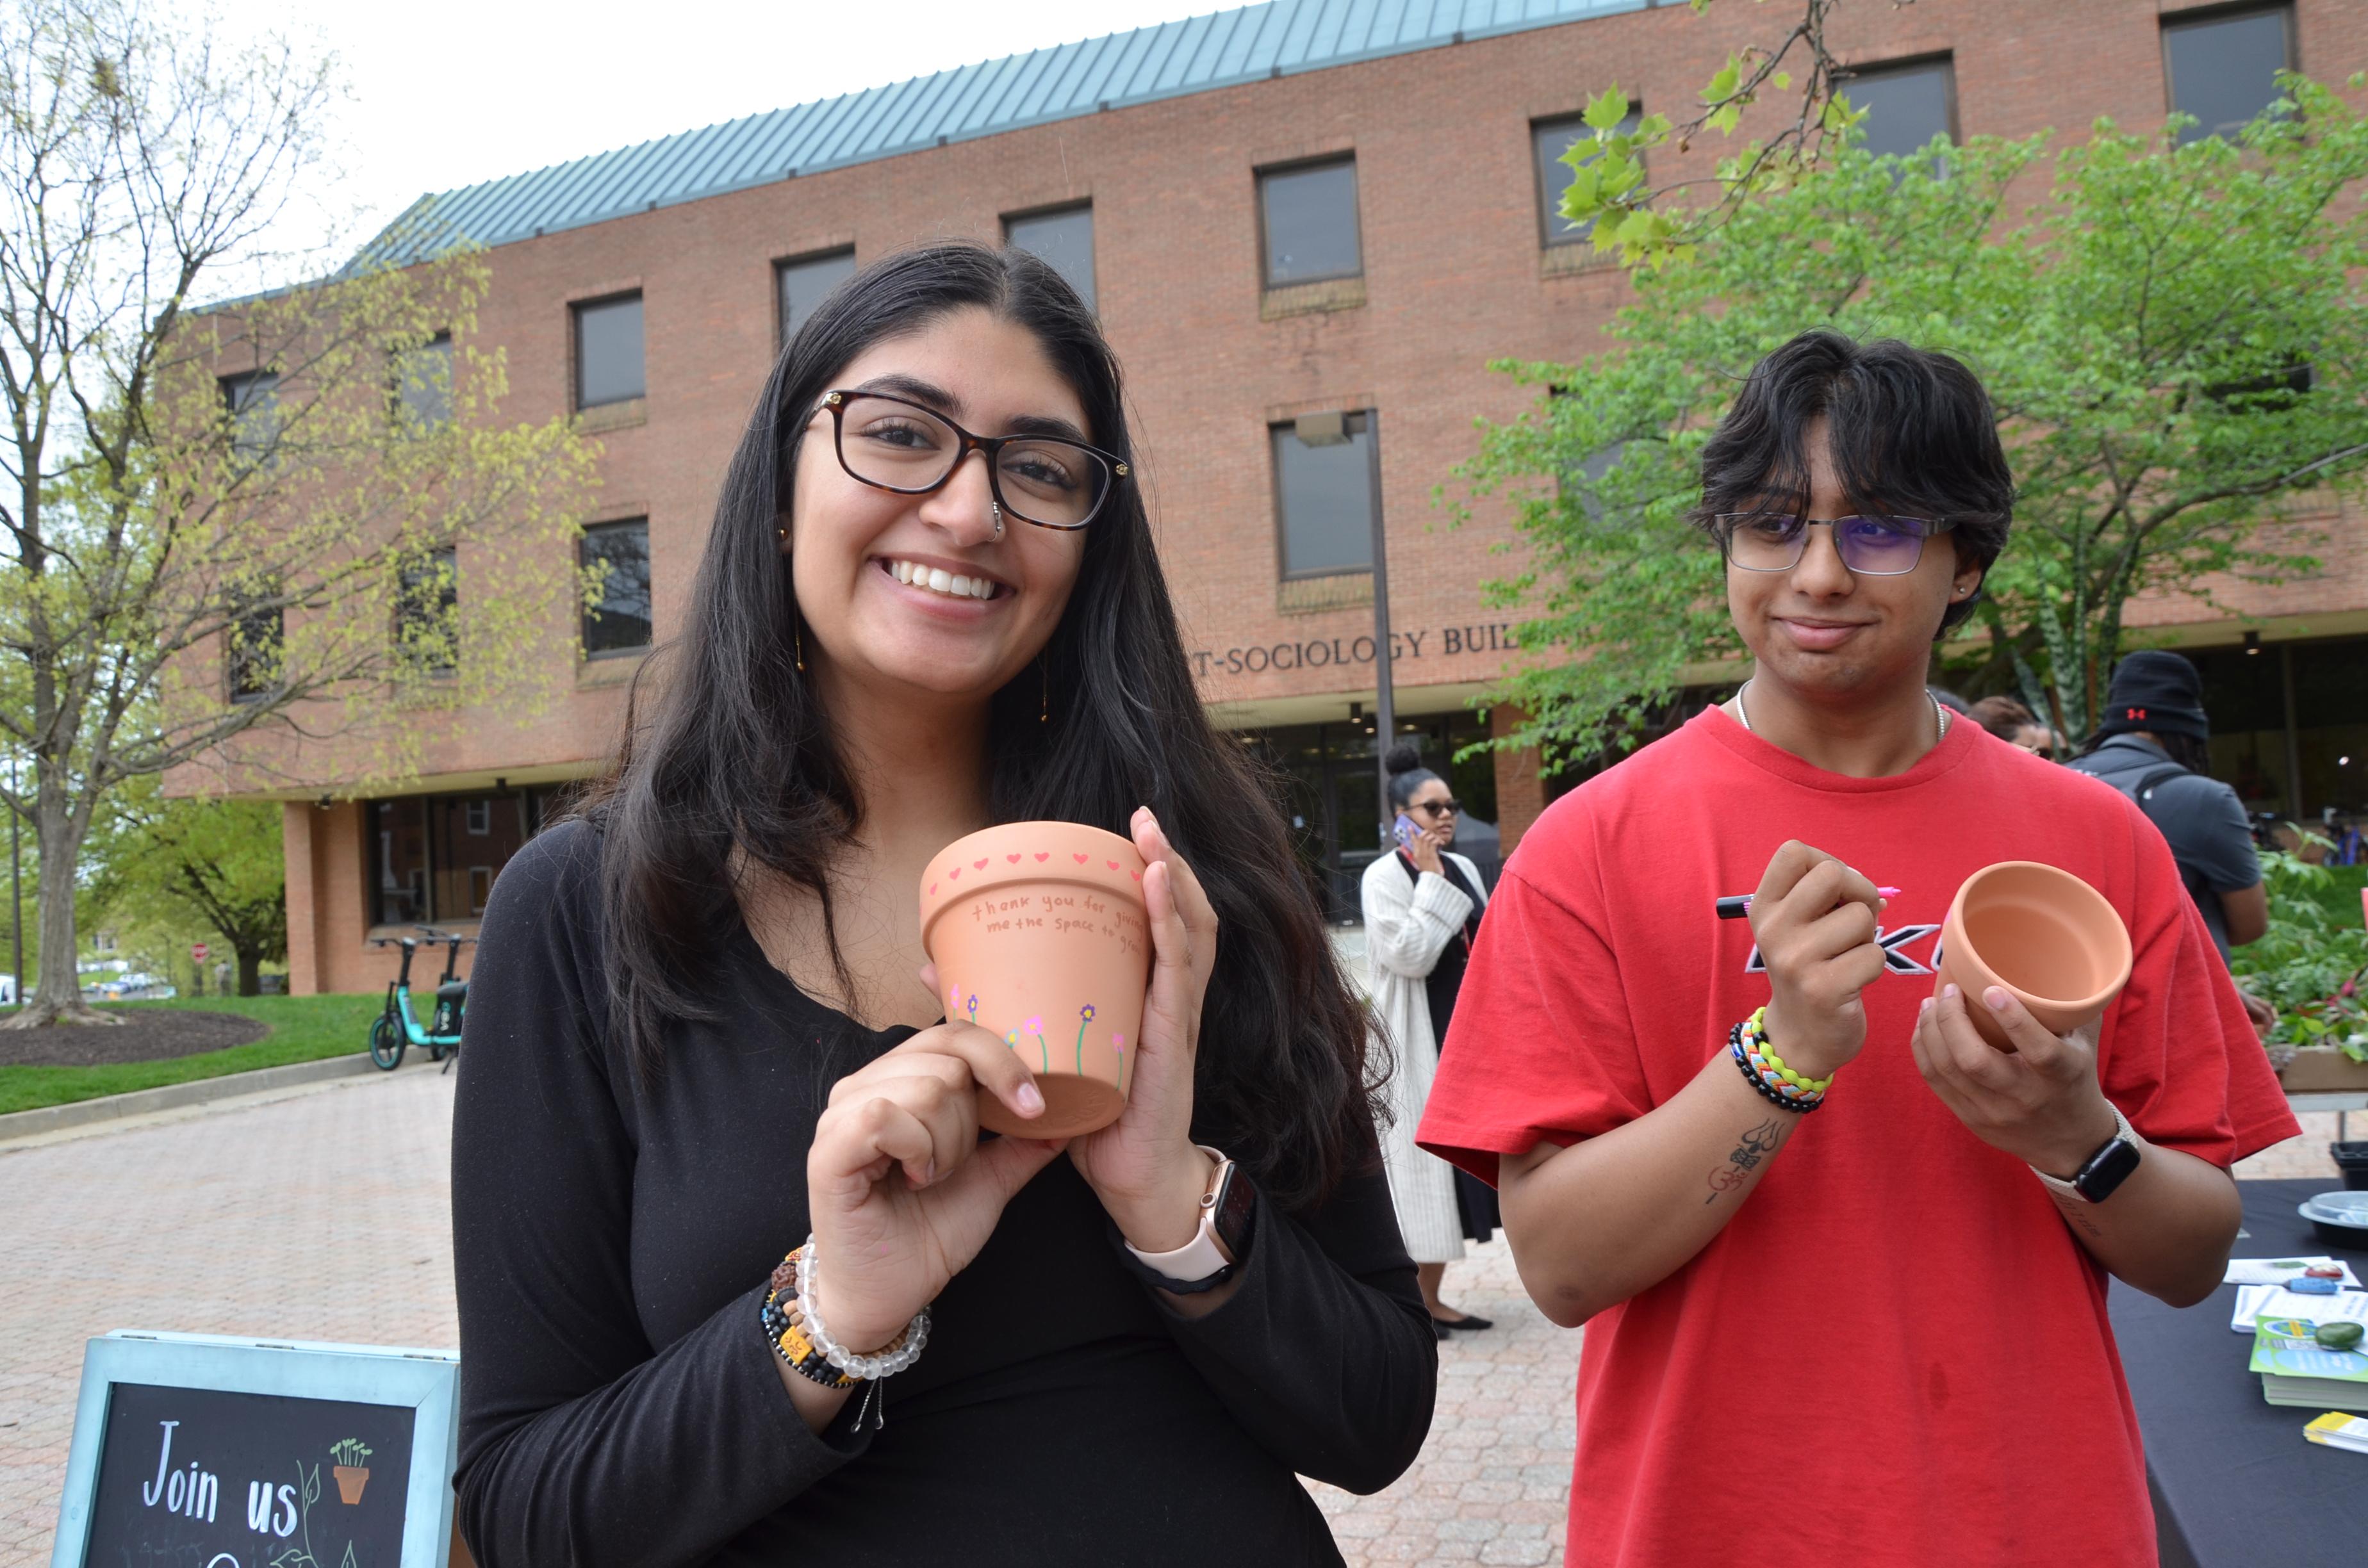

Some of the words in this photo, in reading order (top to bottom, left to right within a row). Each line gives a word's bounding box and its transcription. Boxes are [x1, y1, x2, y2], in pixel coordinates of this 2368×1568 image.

[972, 897, 1030, 922] thank
[1042, 895, 1074, 913] you
[1084, 895, 1106, 913] for
[1114, 911, 1144, 943] giving
[987, 920, 1010, 933] me
[1015, 917, 1043, 929] the
[1102, 924, 1115, 937] to
[143, 1420, 218, 1523] Join
[247, 1480, 299, 1537] us
